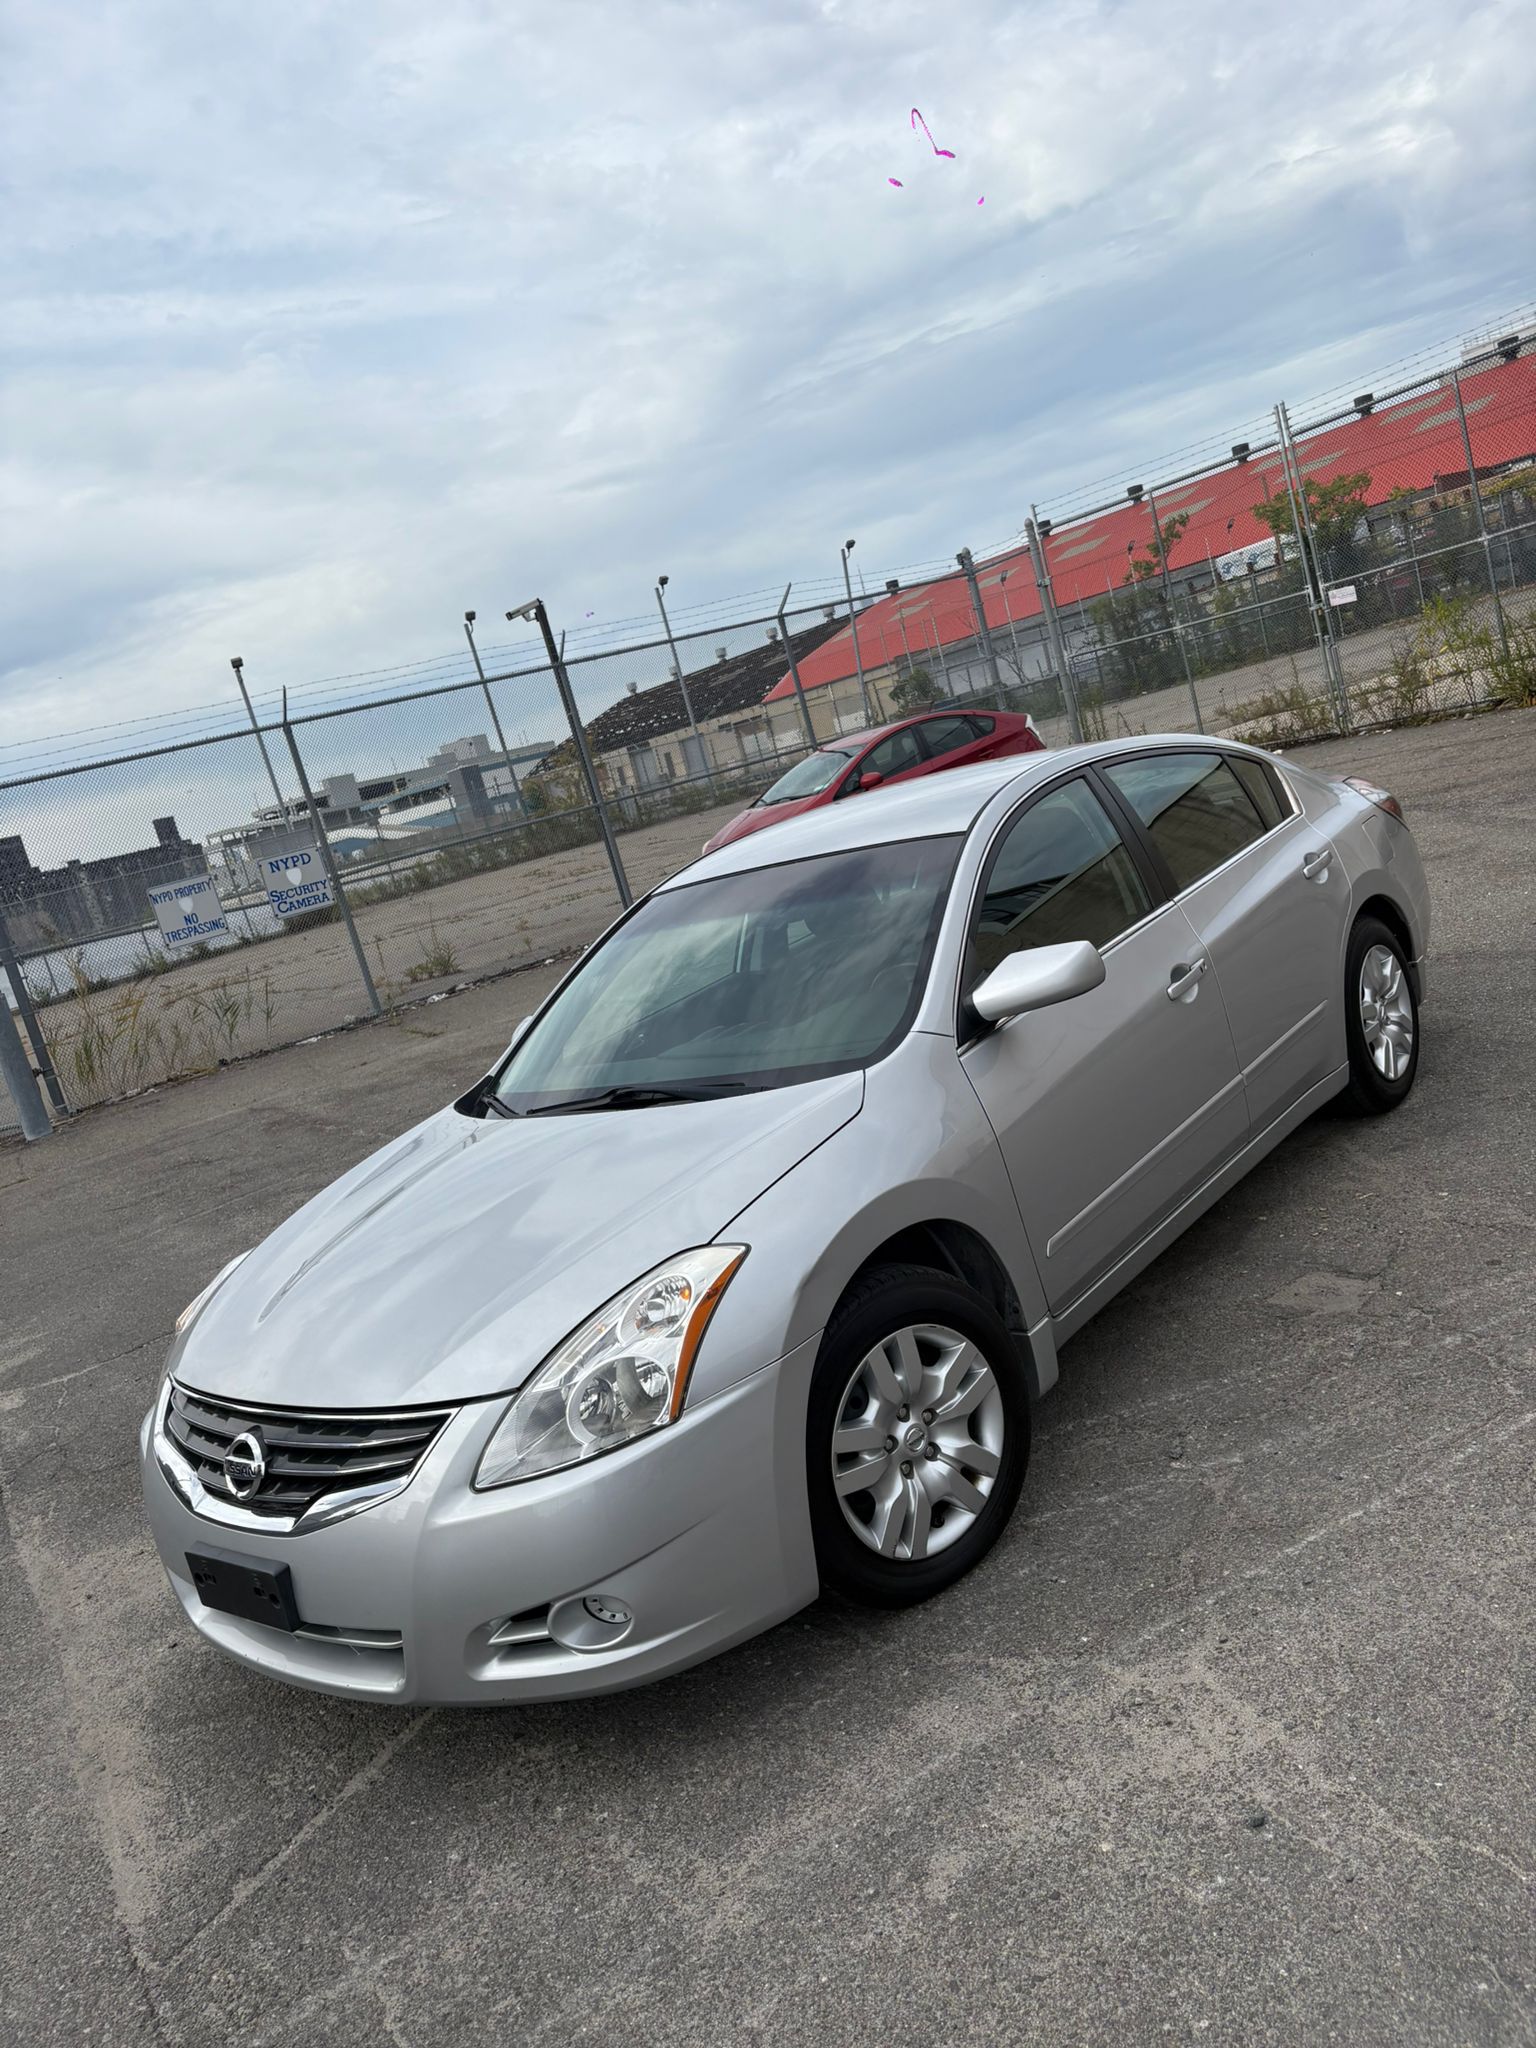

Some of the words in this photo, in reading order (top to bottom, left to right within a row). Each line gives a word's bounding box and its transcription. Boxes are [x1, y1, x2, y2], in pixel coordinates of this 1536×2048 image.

[268, 852, 312, 873] NYPD
[151, 890, 174, 905] NYPD
[174, 880, 212, 898] PROPERTY
[270, 880, 327, 903] SECURITY
[277, 893, 330, 913] CAMERA
[183, 913, 199, 926] NO
[165, 918, 226, 944] TRESPASSING
[226, 1461, 257, 1478] SSAN
